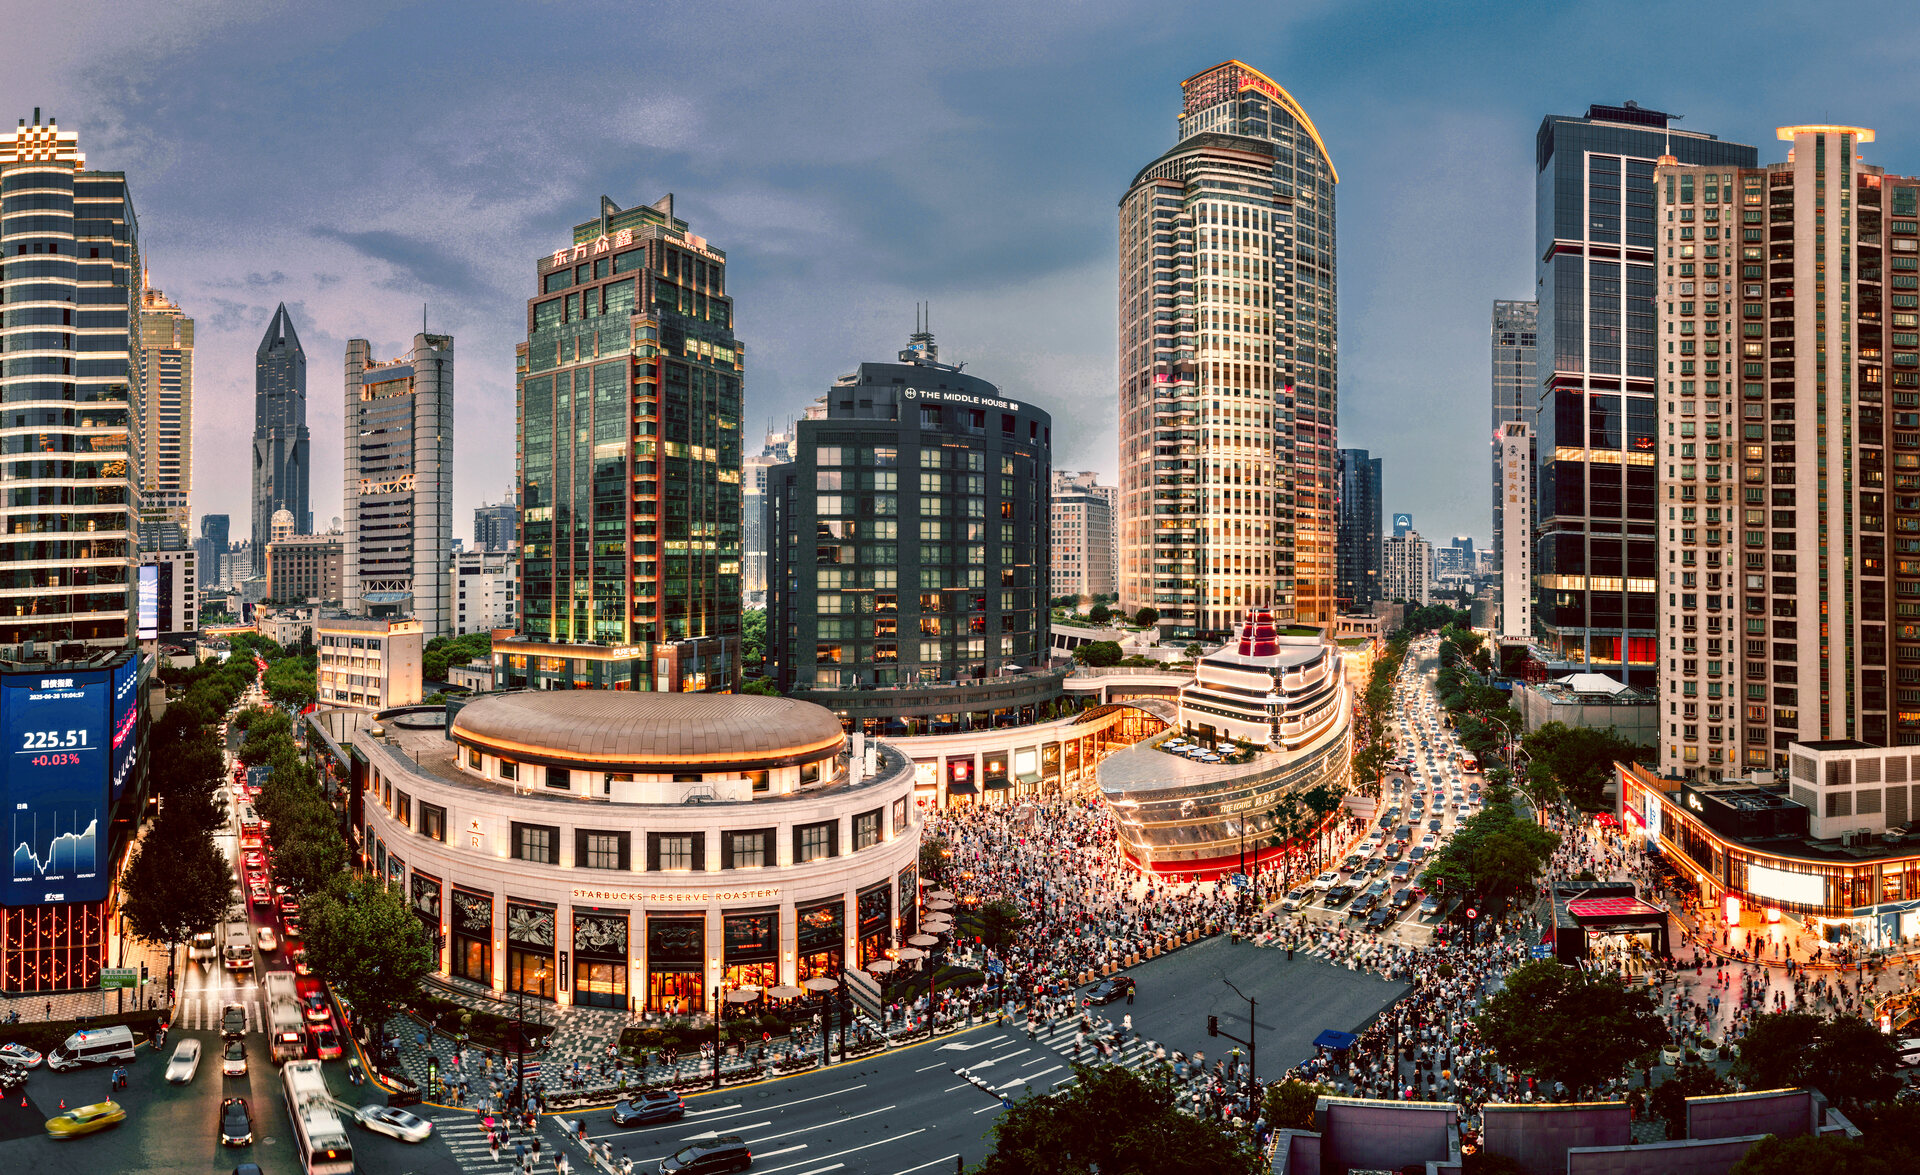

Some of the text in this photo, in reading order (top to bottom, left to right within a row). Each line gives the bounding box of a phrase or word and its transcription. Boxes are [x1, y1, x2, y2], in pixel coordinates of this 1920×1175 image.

[552, 228, 633, 268] 东方众鑫
[664, 234, 726, 264] ORIENTAL CENTER
[920, 390, 940, 399] THE
[943, 392, 979, 404] MIDDLE
[981, 397, 1008, 409] HOUSE
[23, 729, 87, 749] 225.51
[31, 753, 80, 766] +0.03%
[471, 836, 479, 848] R
[573, 888, 780, 902] STARBUCKS RESERVE ROASTERY
